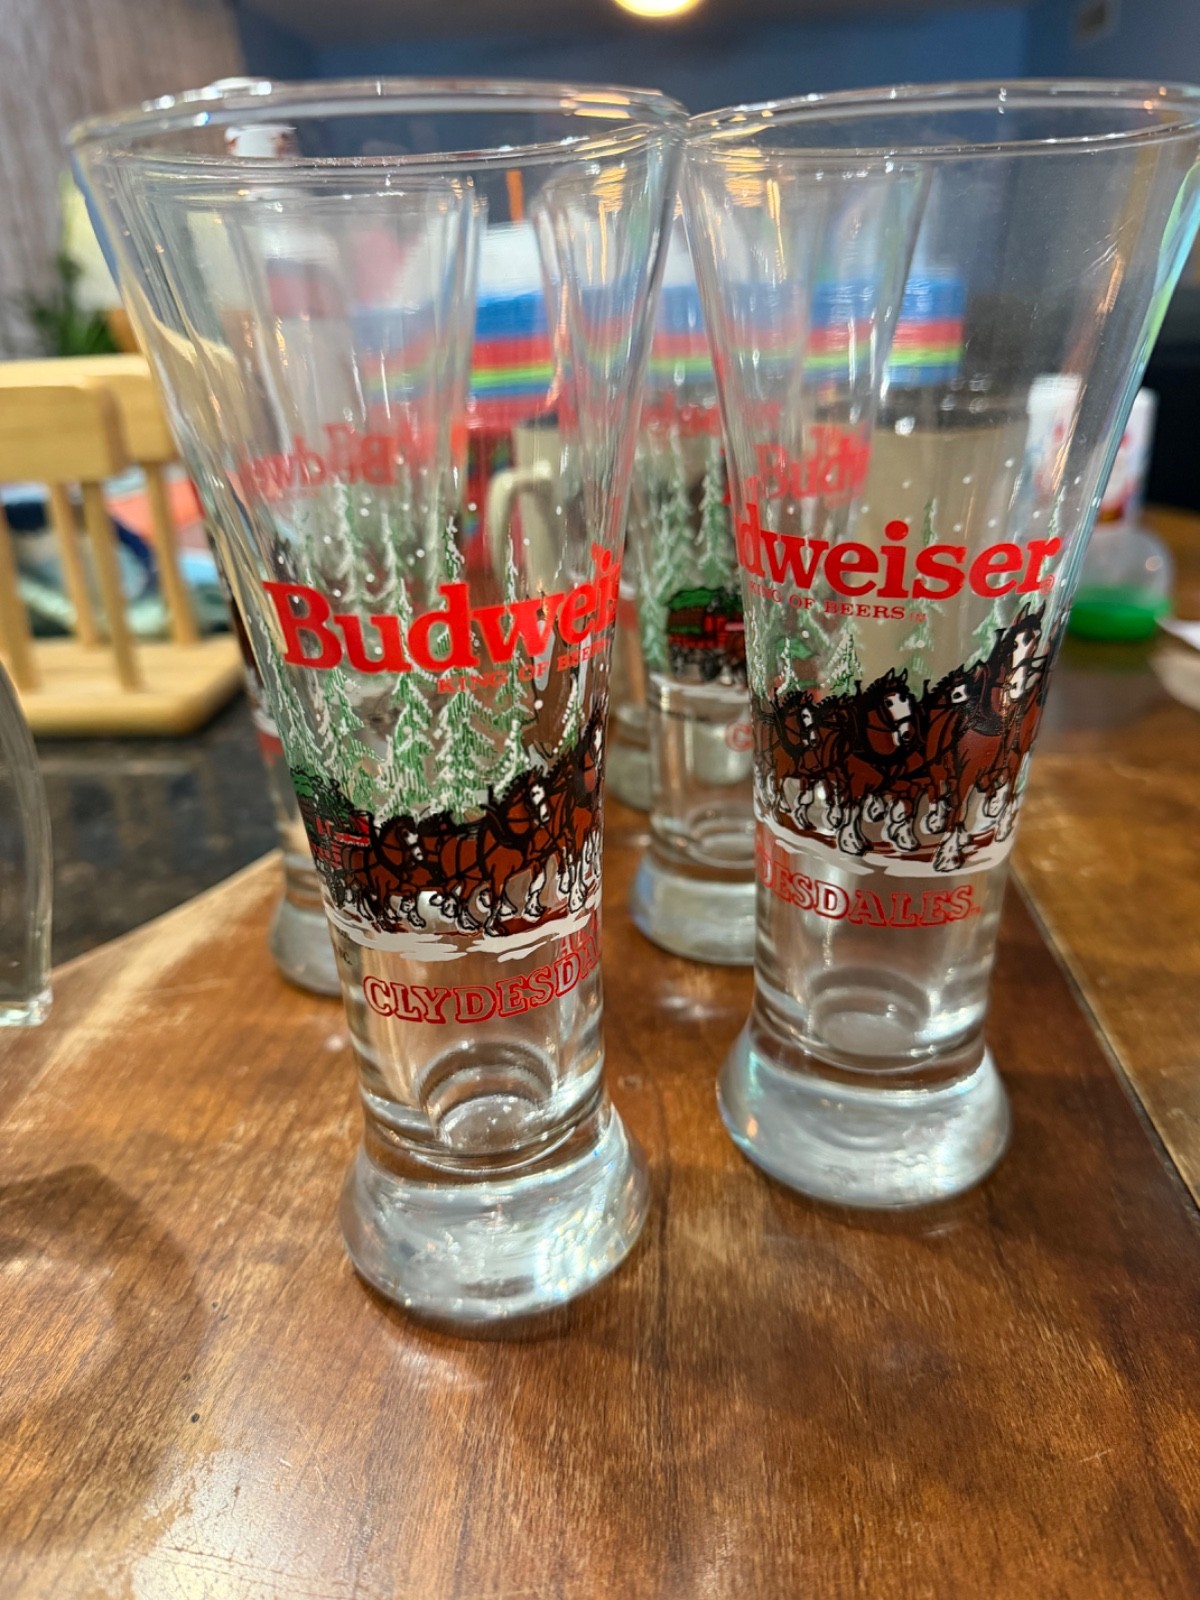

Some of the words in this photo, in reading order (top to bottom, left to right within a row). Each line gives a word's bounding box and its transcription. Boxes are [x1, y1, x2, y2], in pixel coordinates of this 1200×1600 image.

[736, 503, 1062, 600] dweiser
[263, 548, 619, 674] Budwei
[789, 594, 815, 610] OF
[824, 600, 905, 619] BEERS
[437, 670, 508, 694] KING
[518, 661, 550, 682] OF
